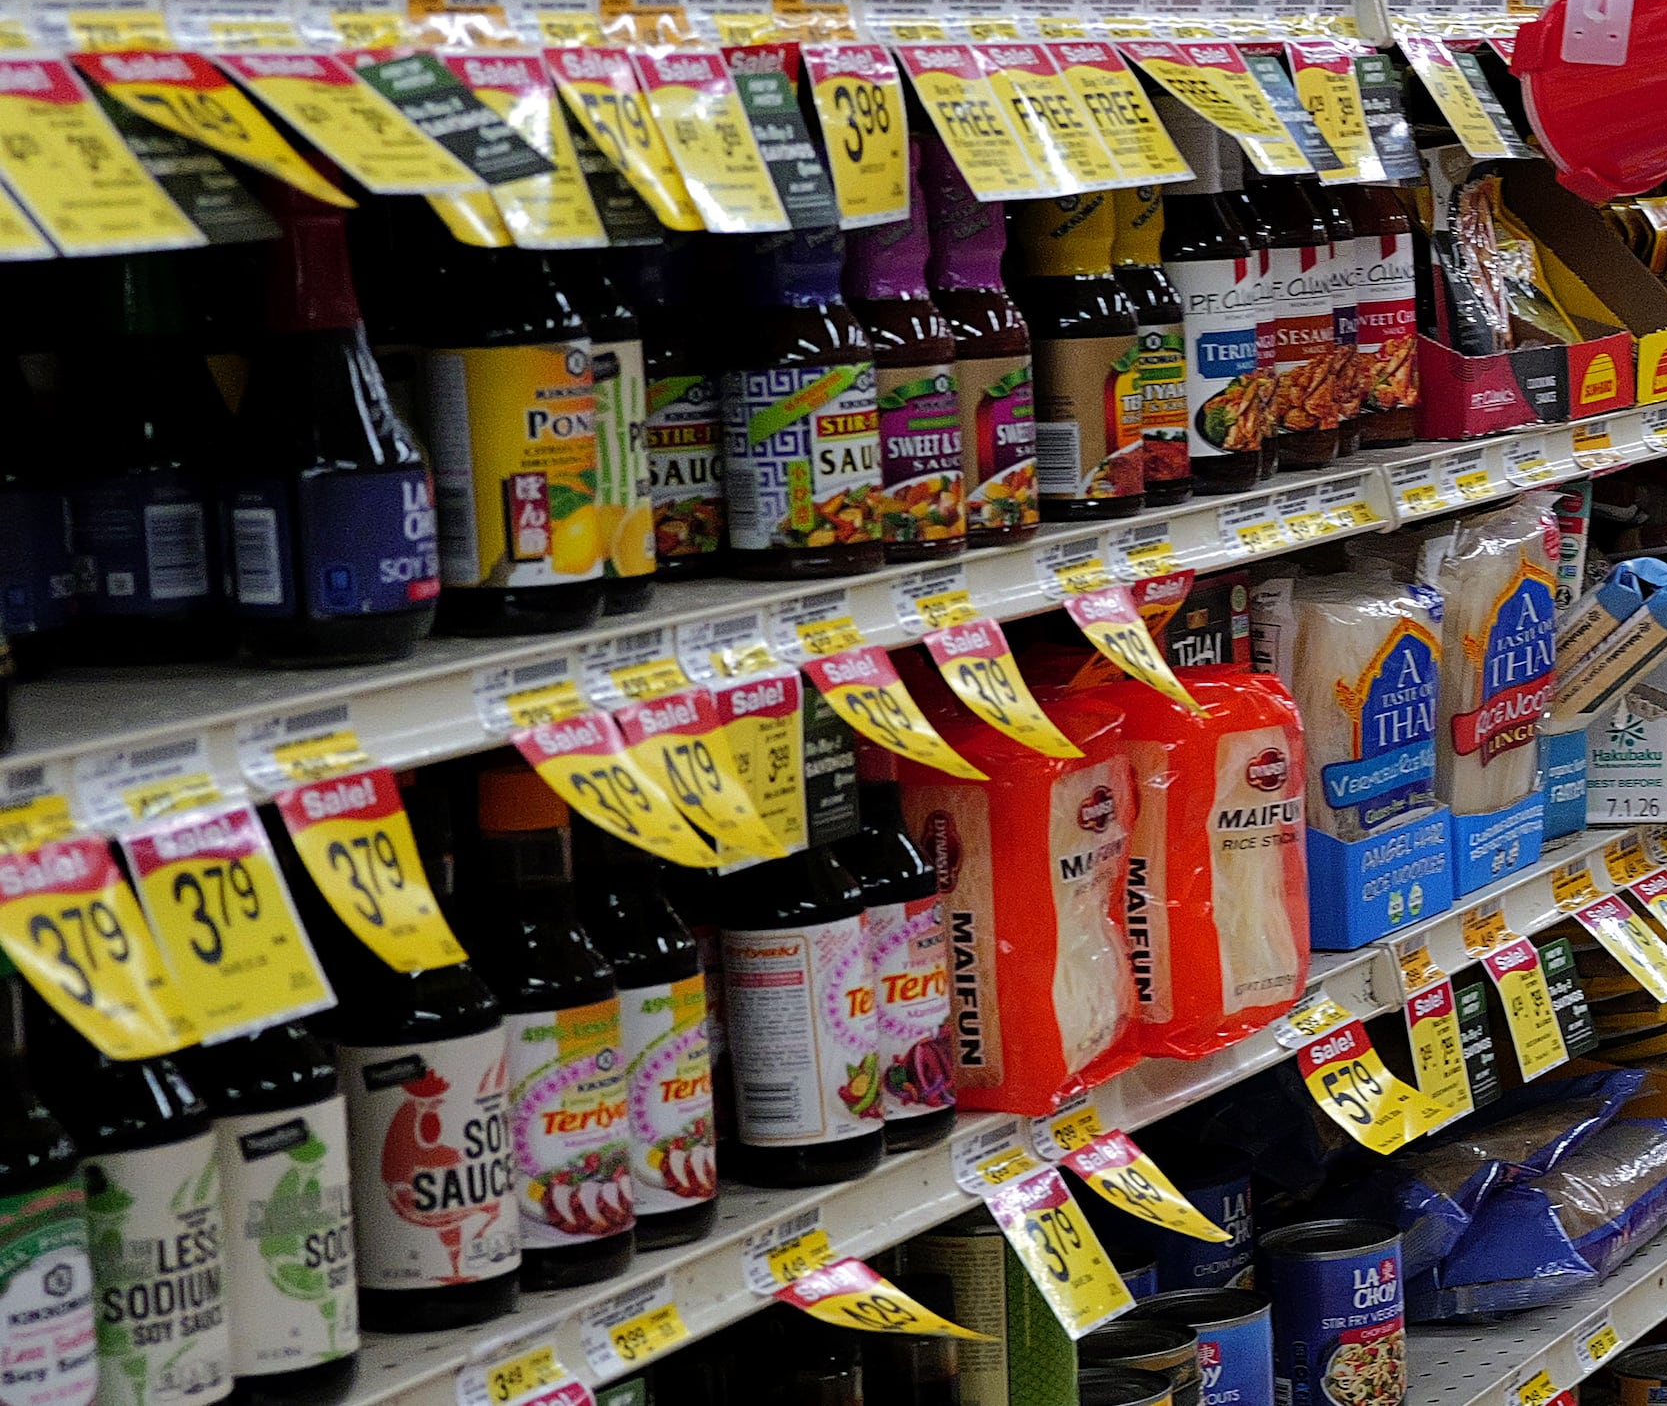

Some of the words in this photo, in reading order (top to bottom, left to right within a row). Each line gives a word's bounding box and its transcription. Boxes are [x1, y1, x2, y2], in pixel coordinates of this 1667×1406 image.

[920, 47, 965, 69] Sale!
[990, 47, 1035, 66] Sale!
[1064, 44, 1106, 63] Sale!
[1192, 47, 1230, 65] Sale!
[463, 58, 532, 86] Sale!
[834, 84, 892, 163] 398
[936, 101, 1005, 138] FREE
[1011, 96, 1083, 134] FREE
[1084, 91, 1150, 125] FREE
[887, 436, 941, 459] SWEET
[1143, 577, 1183, 601] Sale!
[1080, 593, 1120, 619] Sale!
[1516, 592, 1538, 630] A
[940, 625, 991, 654] Sale!
[821, 655, 876, 683] Sale!
[1397, 649, 1421, 688] A
[731, 680, 785, 713] Sale!
[957, 655, 1017, 726] 379
[638, 698, 698, 732] Sale!
[847, 685, 908, 747] 379
[535, 721, 603, 756] Sale!
[1592, 749, 1663, 763] Hakubaku
[661, 741, 722, 818] 479
[1587, 779, 1615, 789] BEST
[1618, 779, 1662, 788] BEFORE
[303, 777, 378, 820] Sale!
[570, 763, 652, 836] 379
[1607, 798, 1660, 817] 7.1.26
[1222, 836, 1258, 852] RICE
[328, 829, 406, 929] 379
[173, 860, 261, 965] 379
[1127, 857, 1152, 1003] MAIFUN
[26, 900, 130, 1008] 379
[1494, 948, 1529, 970] Sale!
[952, 911, 983, 1067] MAIFUN
[1415, 991, 1444, 1016] Sale!
[1307, 1032, 1354, 1065] Sale!
[1320, 1060, 1384, 1126] 579
[1075, 1138, 1122, 1170] Sale!
[1223, 1194, 1247, 1222] LA
[1025, 1210, 1080, 1284] 379
[1353, 1280, 1397, 1308] CHOY
[1354, 1267, 1381, 1290] LA
[1321, 1317, 1346, 1330] STIR
[1349, 1314, 1369, 1327] FRY
[611, 1323, 647, 1358] 399
